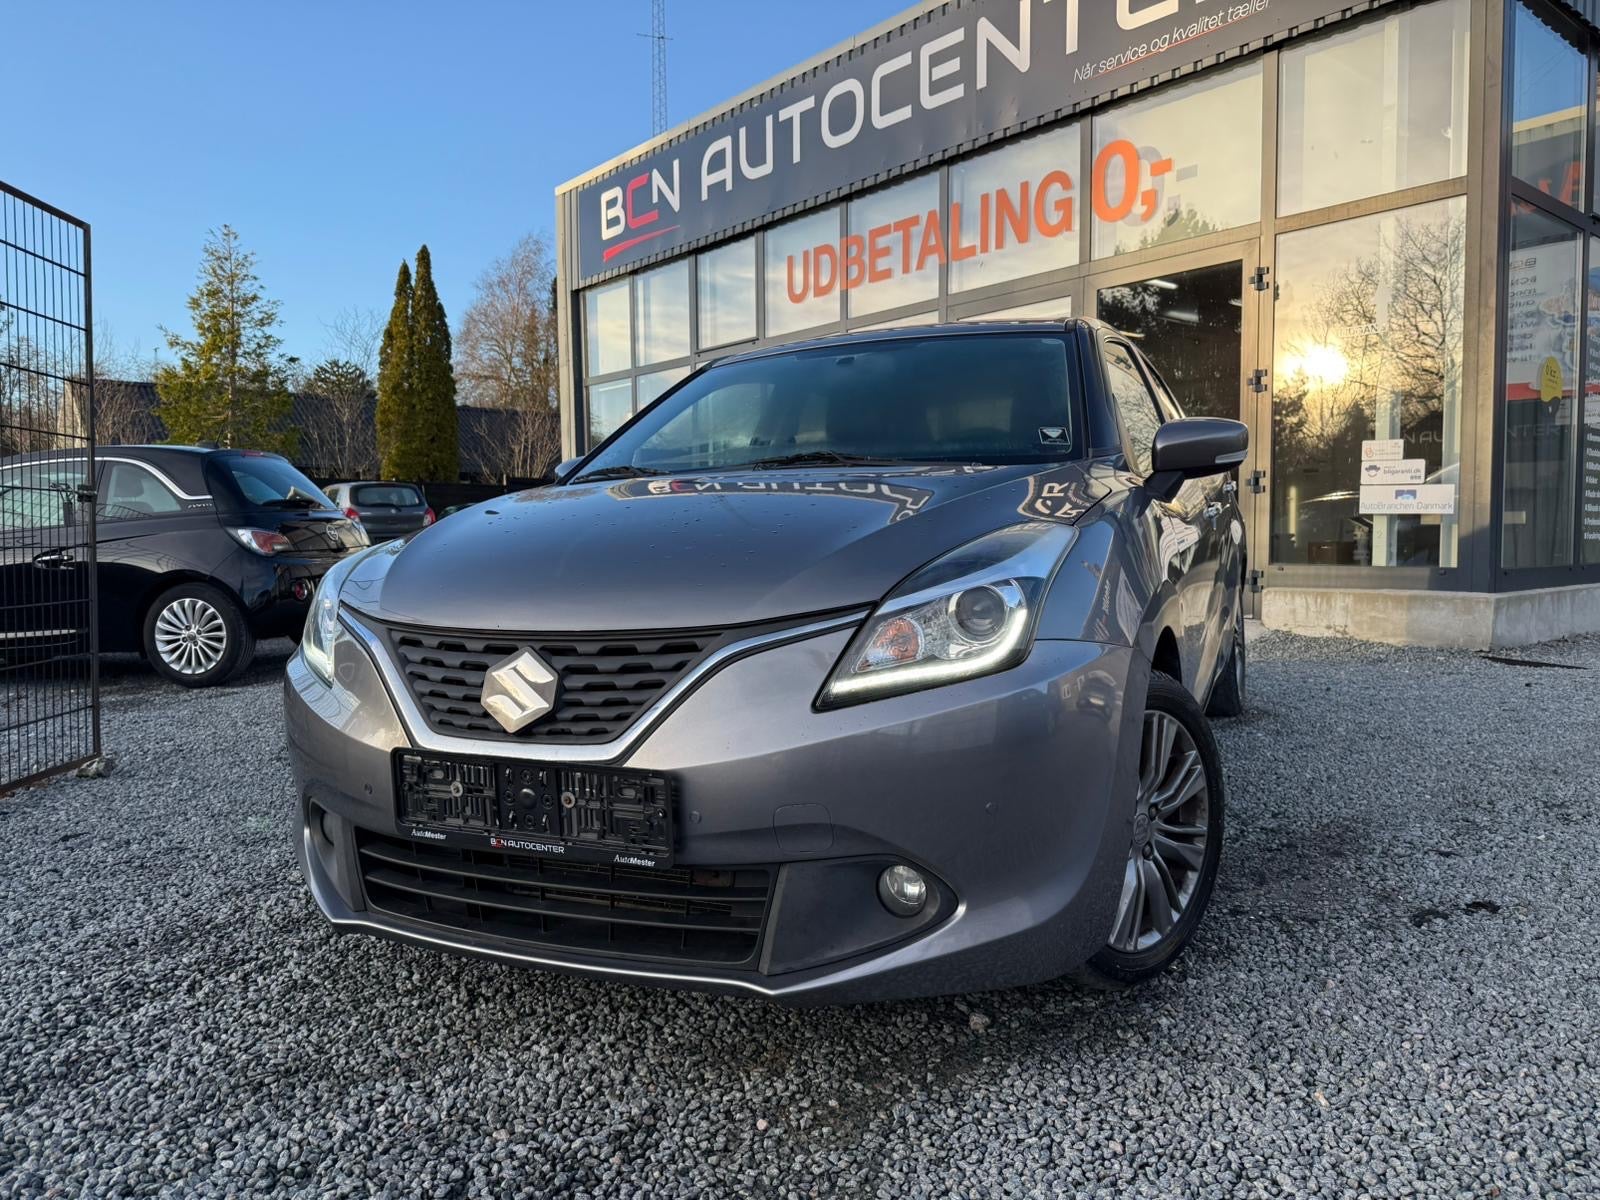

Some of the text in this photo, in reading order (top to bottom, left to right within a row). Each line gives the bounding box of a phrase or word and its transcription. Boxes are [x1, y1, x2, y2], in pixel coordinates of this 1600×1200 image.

[1073, 62, 1097, 84] Når
[1098, 41, 1147, 73] service
[1150, 33, 1170, 52] og
[1172, 11, 1224, 44] kvalitet
[600, 0, 1208, 241] BCN AUTOCENT
[786, 169, 1074, 304] UDBETALING
[1416, 500, 1453, 511] Danmark
[411, 828, 447, 840] AutoMester
[507, 840, 565, 854] AUTOCENTER
[613, 854, 656, 867] AutoMester
